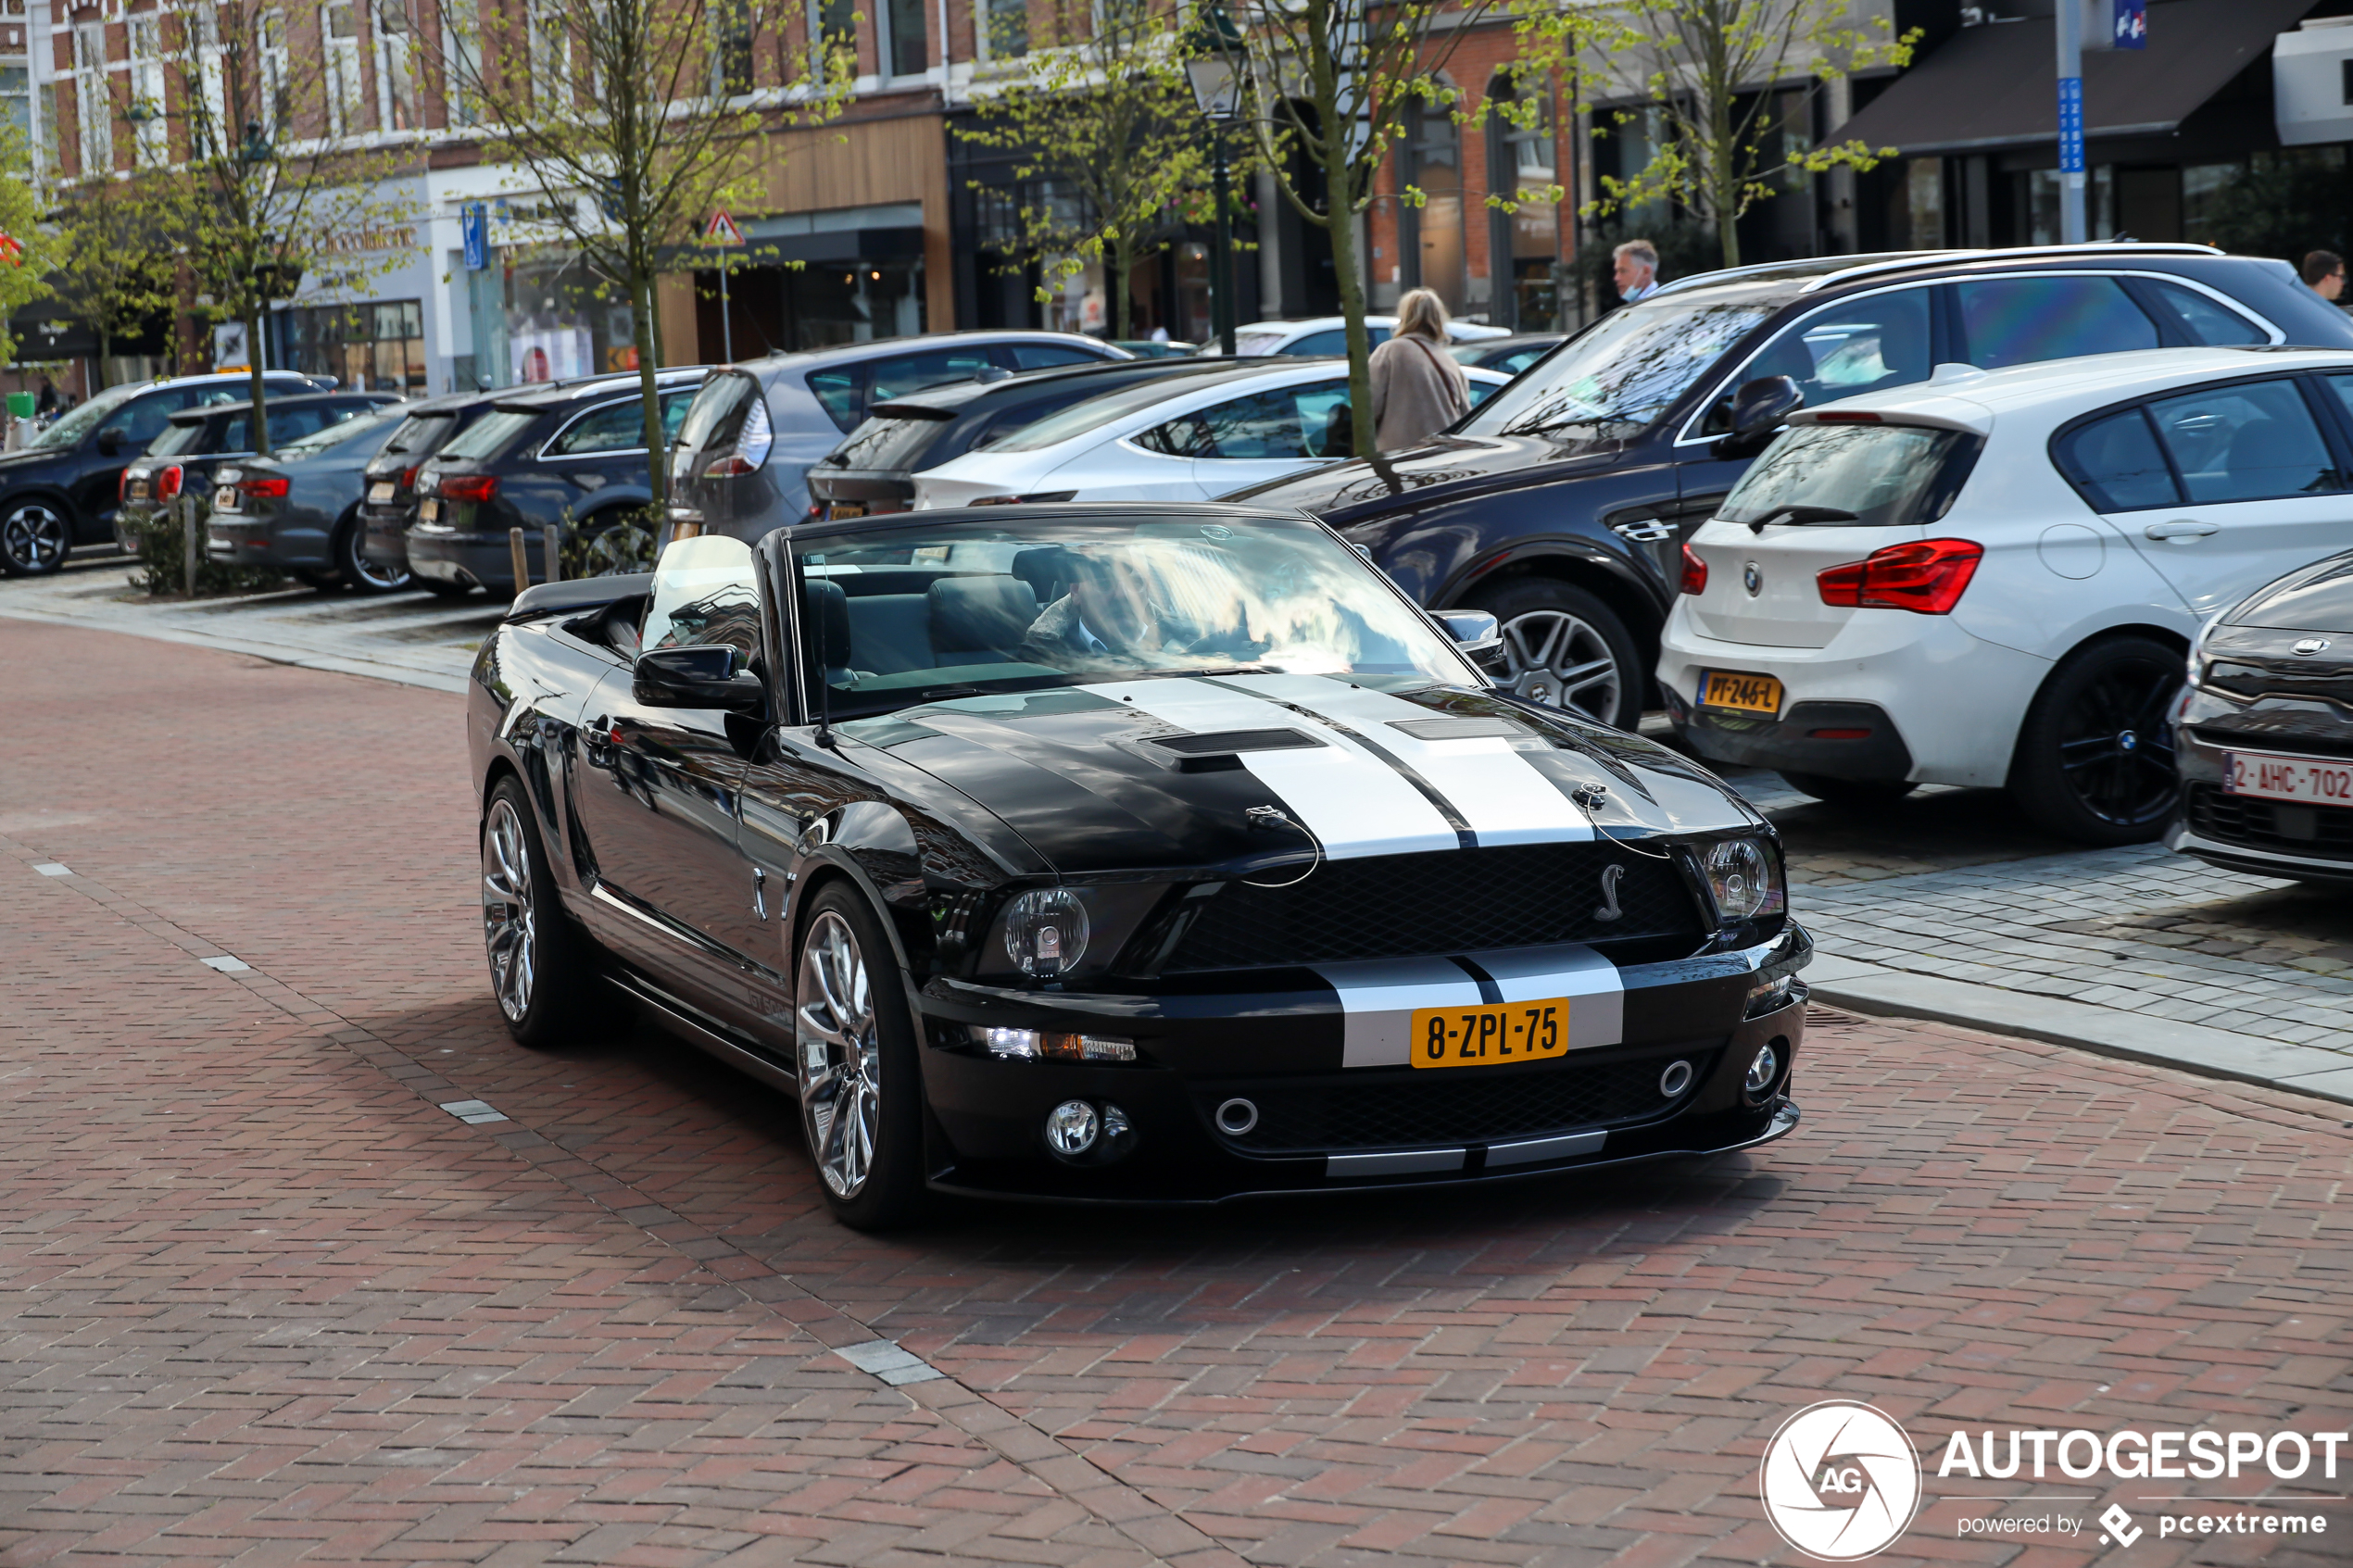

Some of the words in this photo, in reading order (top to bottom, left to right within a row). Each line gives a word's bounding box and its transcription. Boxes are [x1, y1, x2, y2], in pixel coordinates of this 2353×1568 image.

[1709, 677, 1772, 708] PT-246-L
[2233, 760, 2351, 798] 2-AHC-702
[1427, 1007, 1558, 1060] 8-ZPL-75
